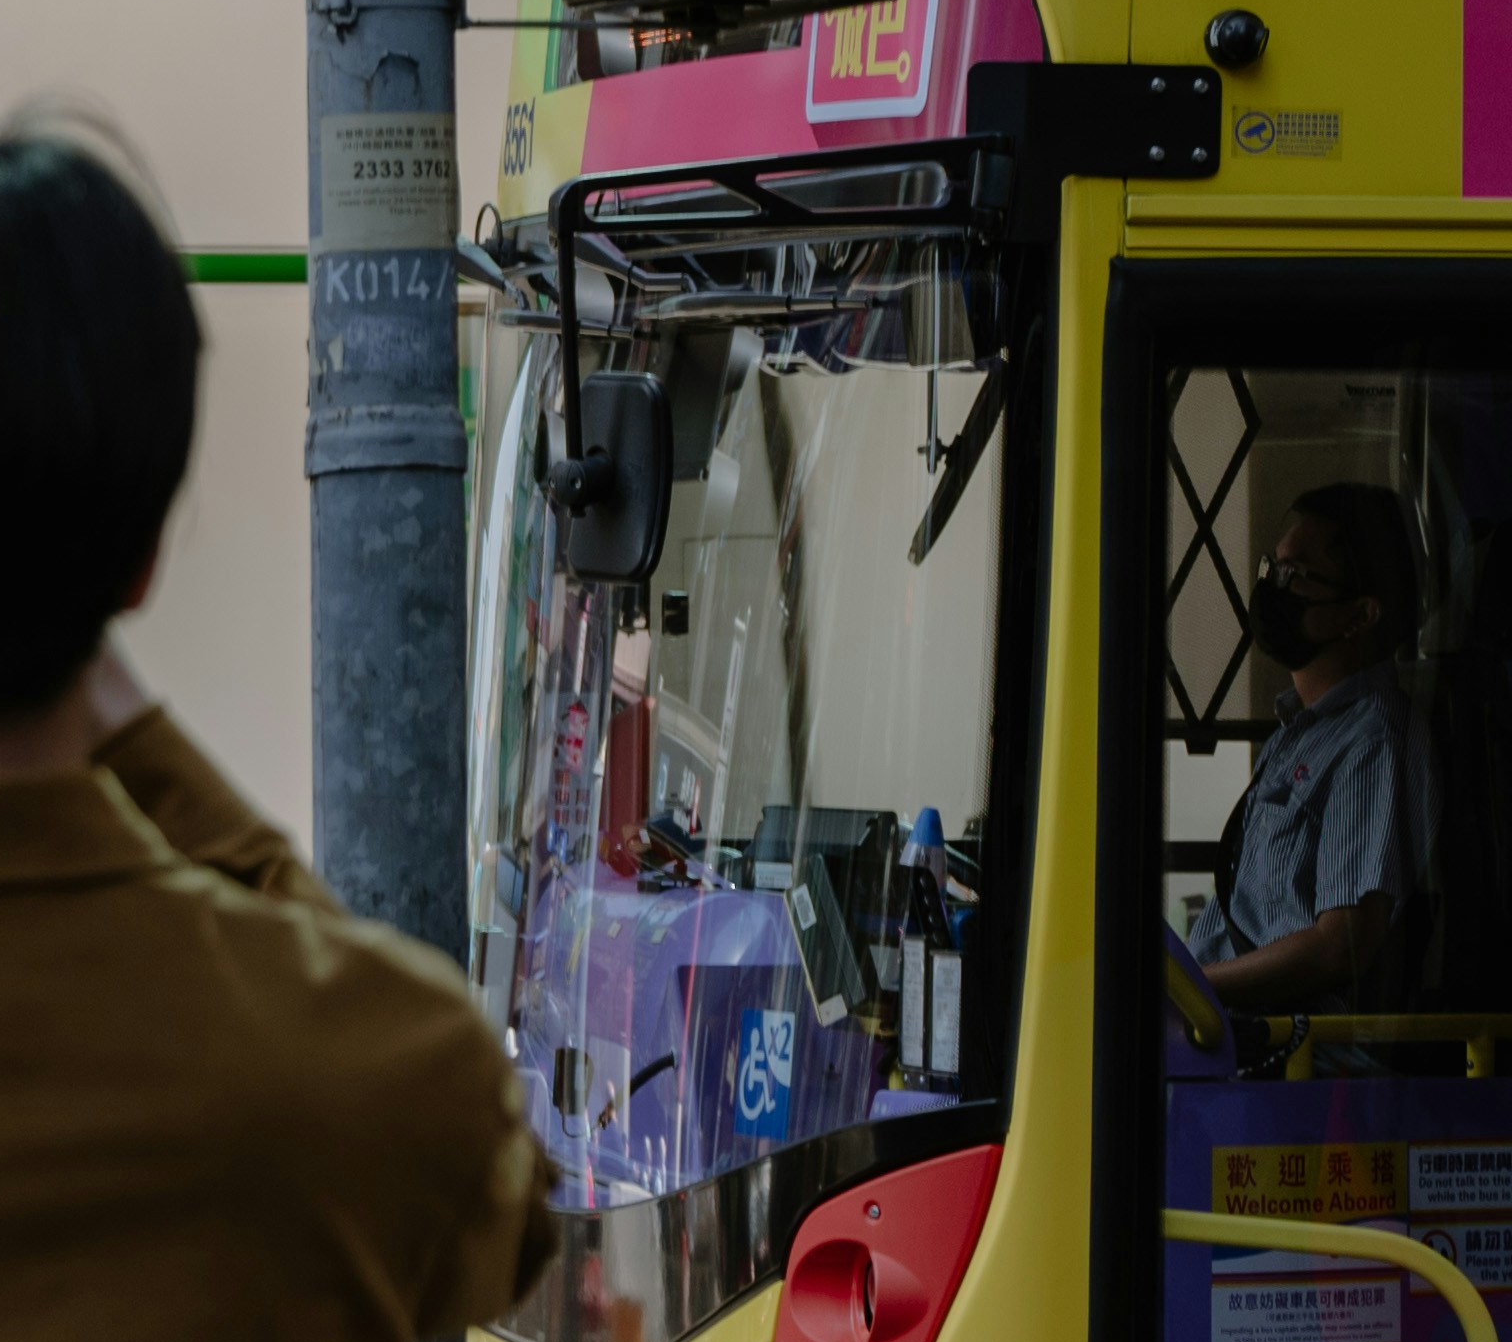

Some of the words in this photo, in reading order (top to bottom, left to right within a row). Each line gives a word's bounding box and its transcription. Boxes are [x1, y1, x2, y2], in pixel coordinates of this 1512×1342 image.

[503, 97, 536, 177] 8561
[354, 160, 404, 179] 2333
[413, 159, 451, 178] 3762
[1226, 1150, 1396, 1189] 歡迎乘搭
[1419, 1176, 1433, 1189] Do
[1436, 1177, 1452, 1188] not
[1456, 1175, 1474, 1187] talk
[1479, 1176, 1490, 1187] to
[1493, 1174, 1511, 1186] the
[1226, 1194, 1323, 1215] Welcome
[1329, 1190, 1396, 1211] Aboard
[1428, 1191, 1455, 1203] while
[1459, 1190, 1476, 1202] the
[1479, 1190, 1499, 1202] bus
[1502, 1189, 1511, 1201] is
[1466, 1254, 1501, 1267] Please
[1481, 1269, 1499, 1281] the
